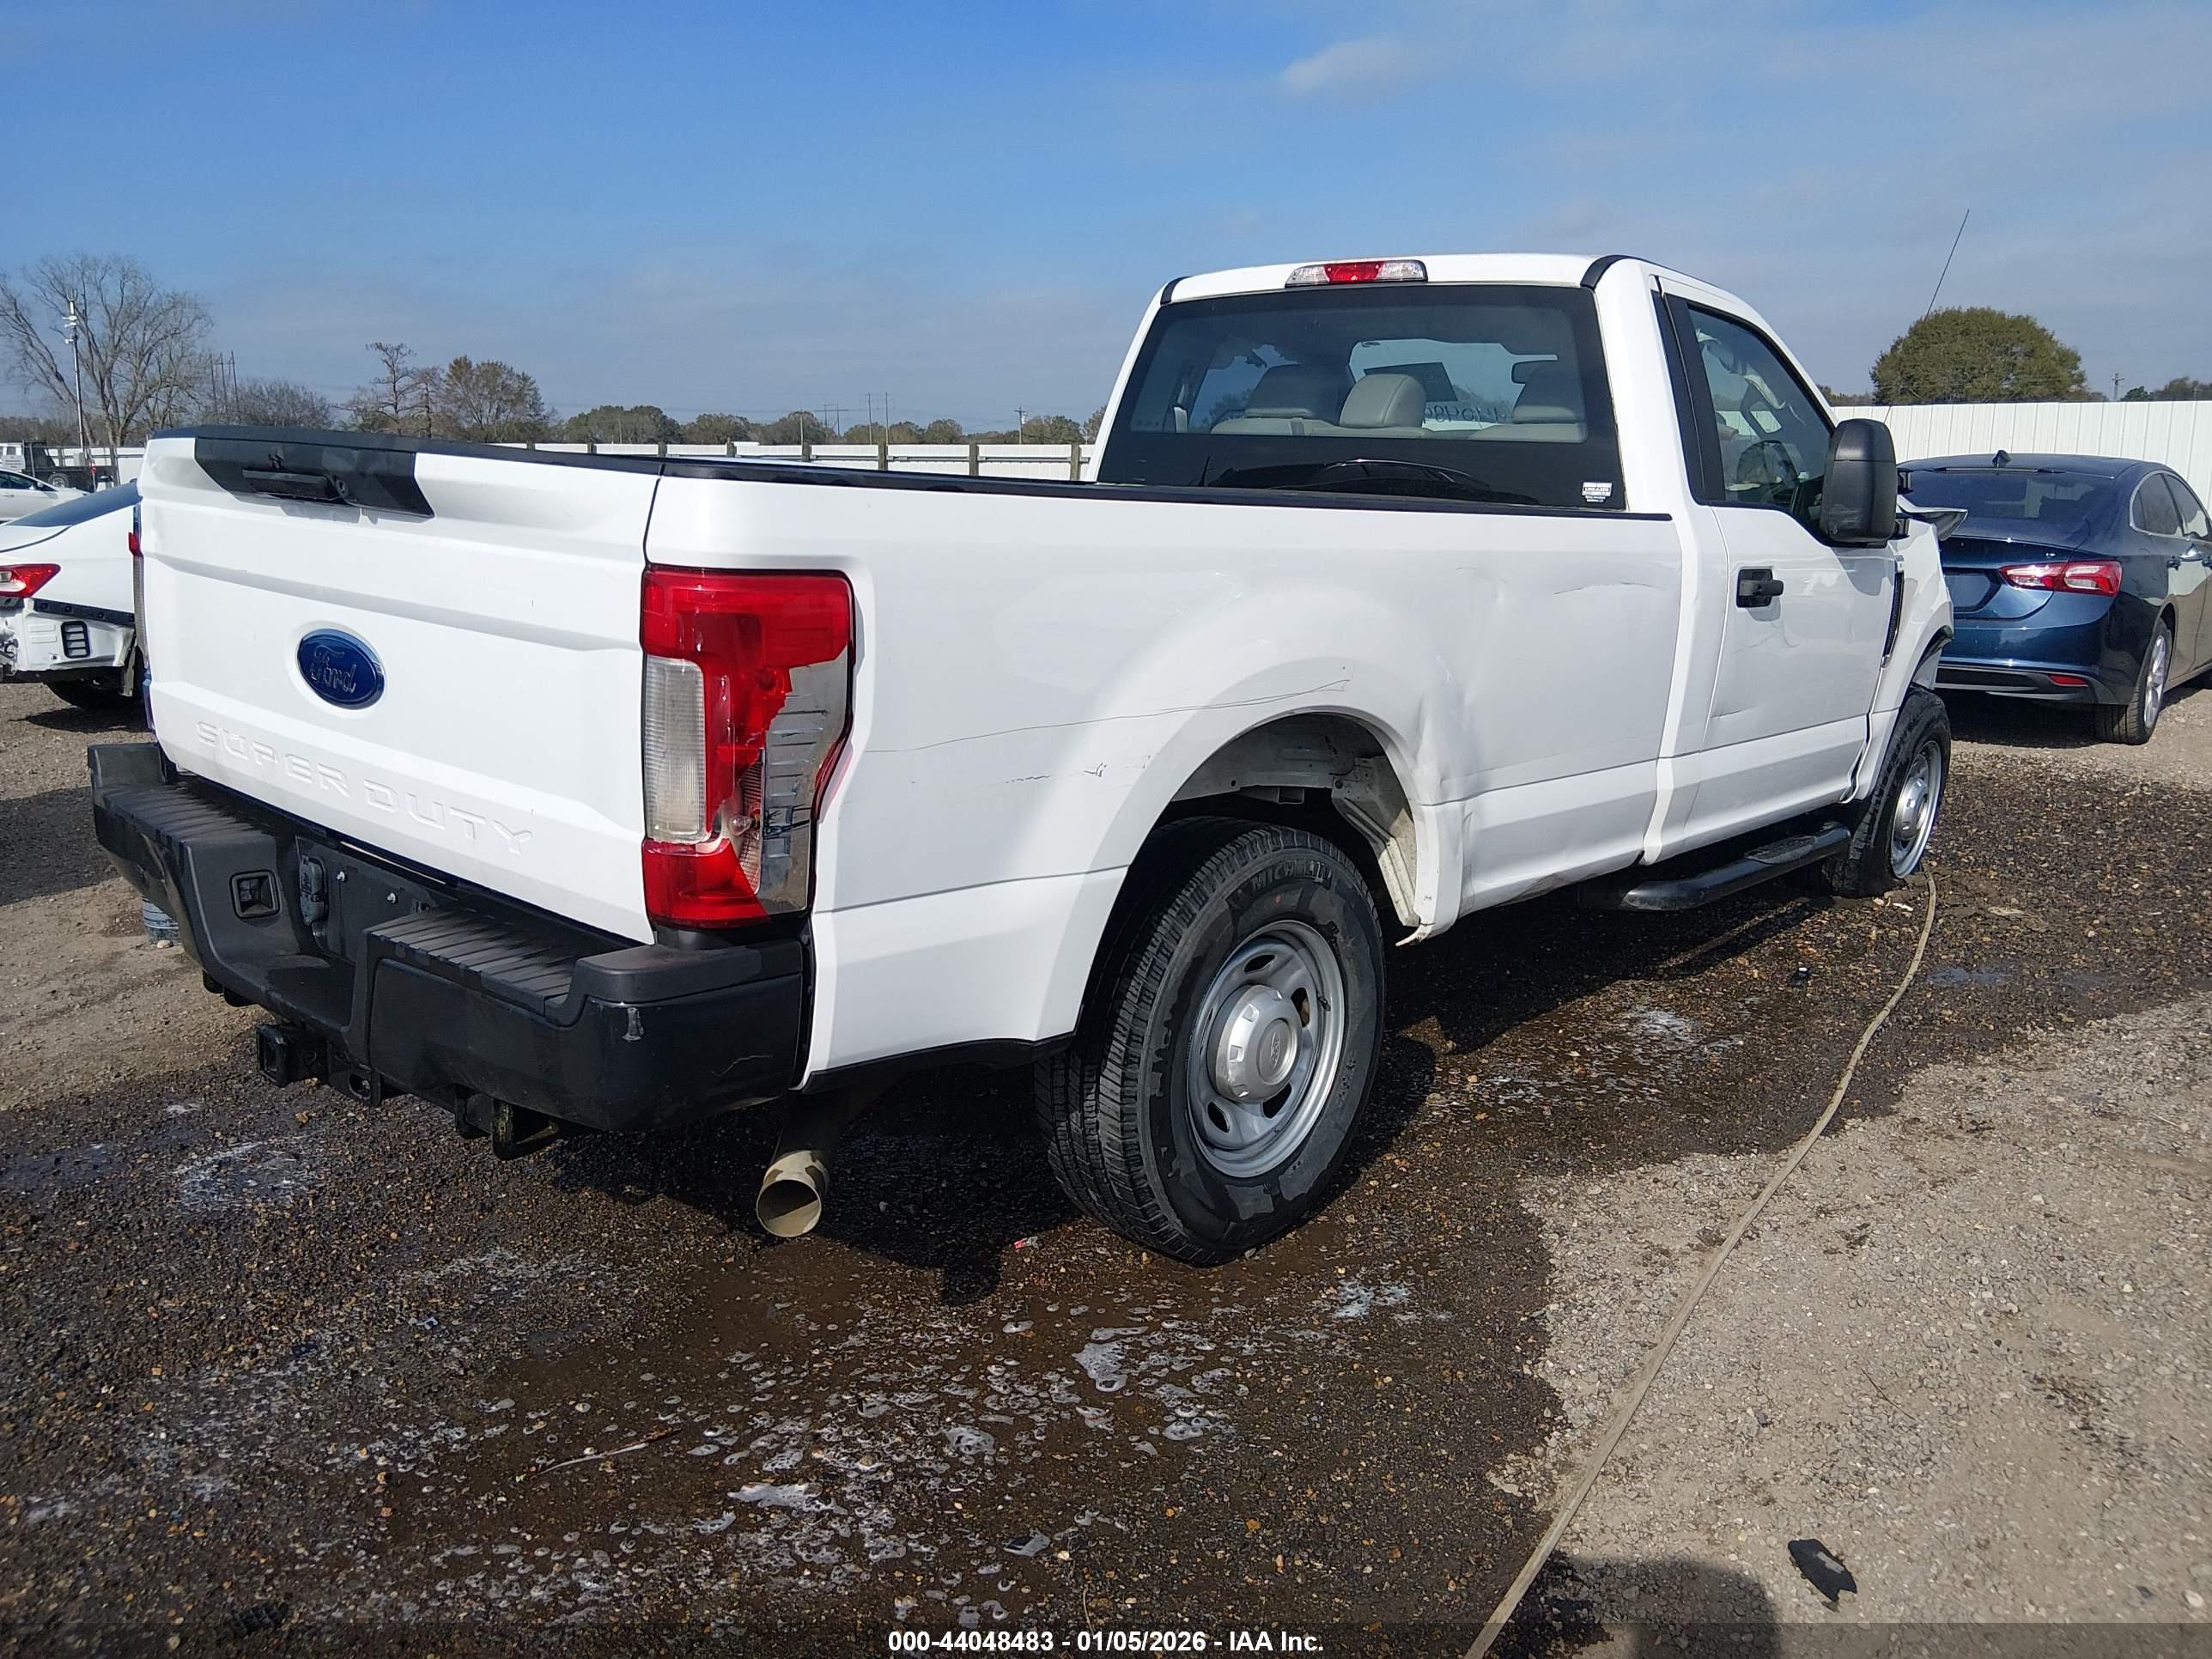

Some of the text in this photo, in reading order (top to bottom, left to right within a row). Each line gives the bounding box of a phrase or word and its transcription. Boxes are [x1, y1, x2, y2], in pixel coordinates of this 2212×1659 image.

[310, 643, 357, 694] Ford
[197, 720, 533, 855] SUPER DUTY
